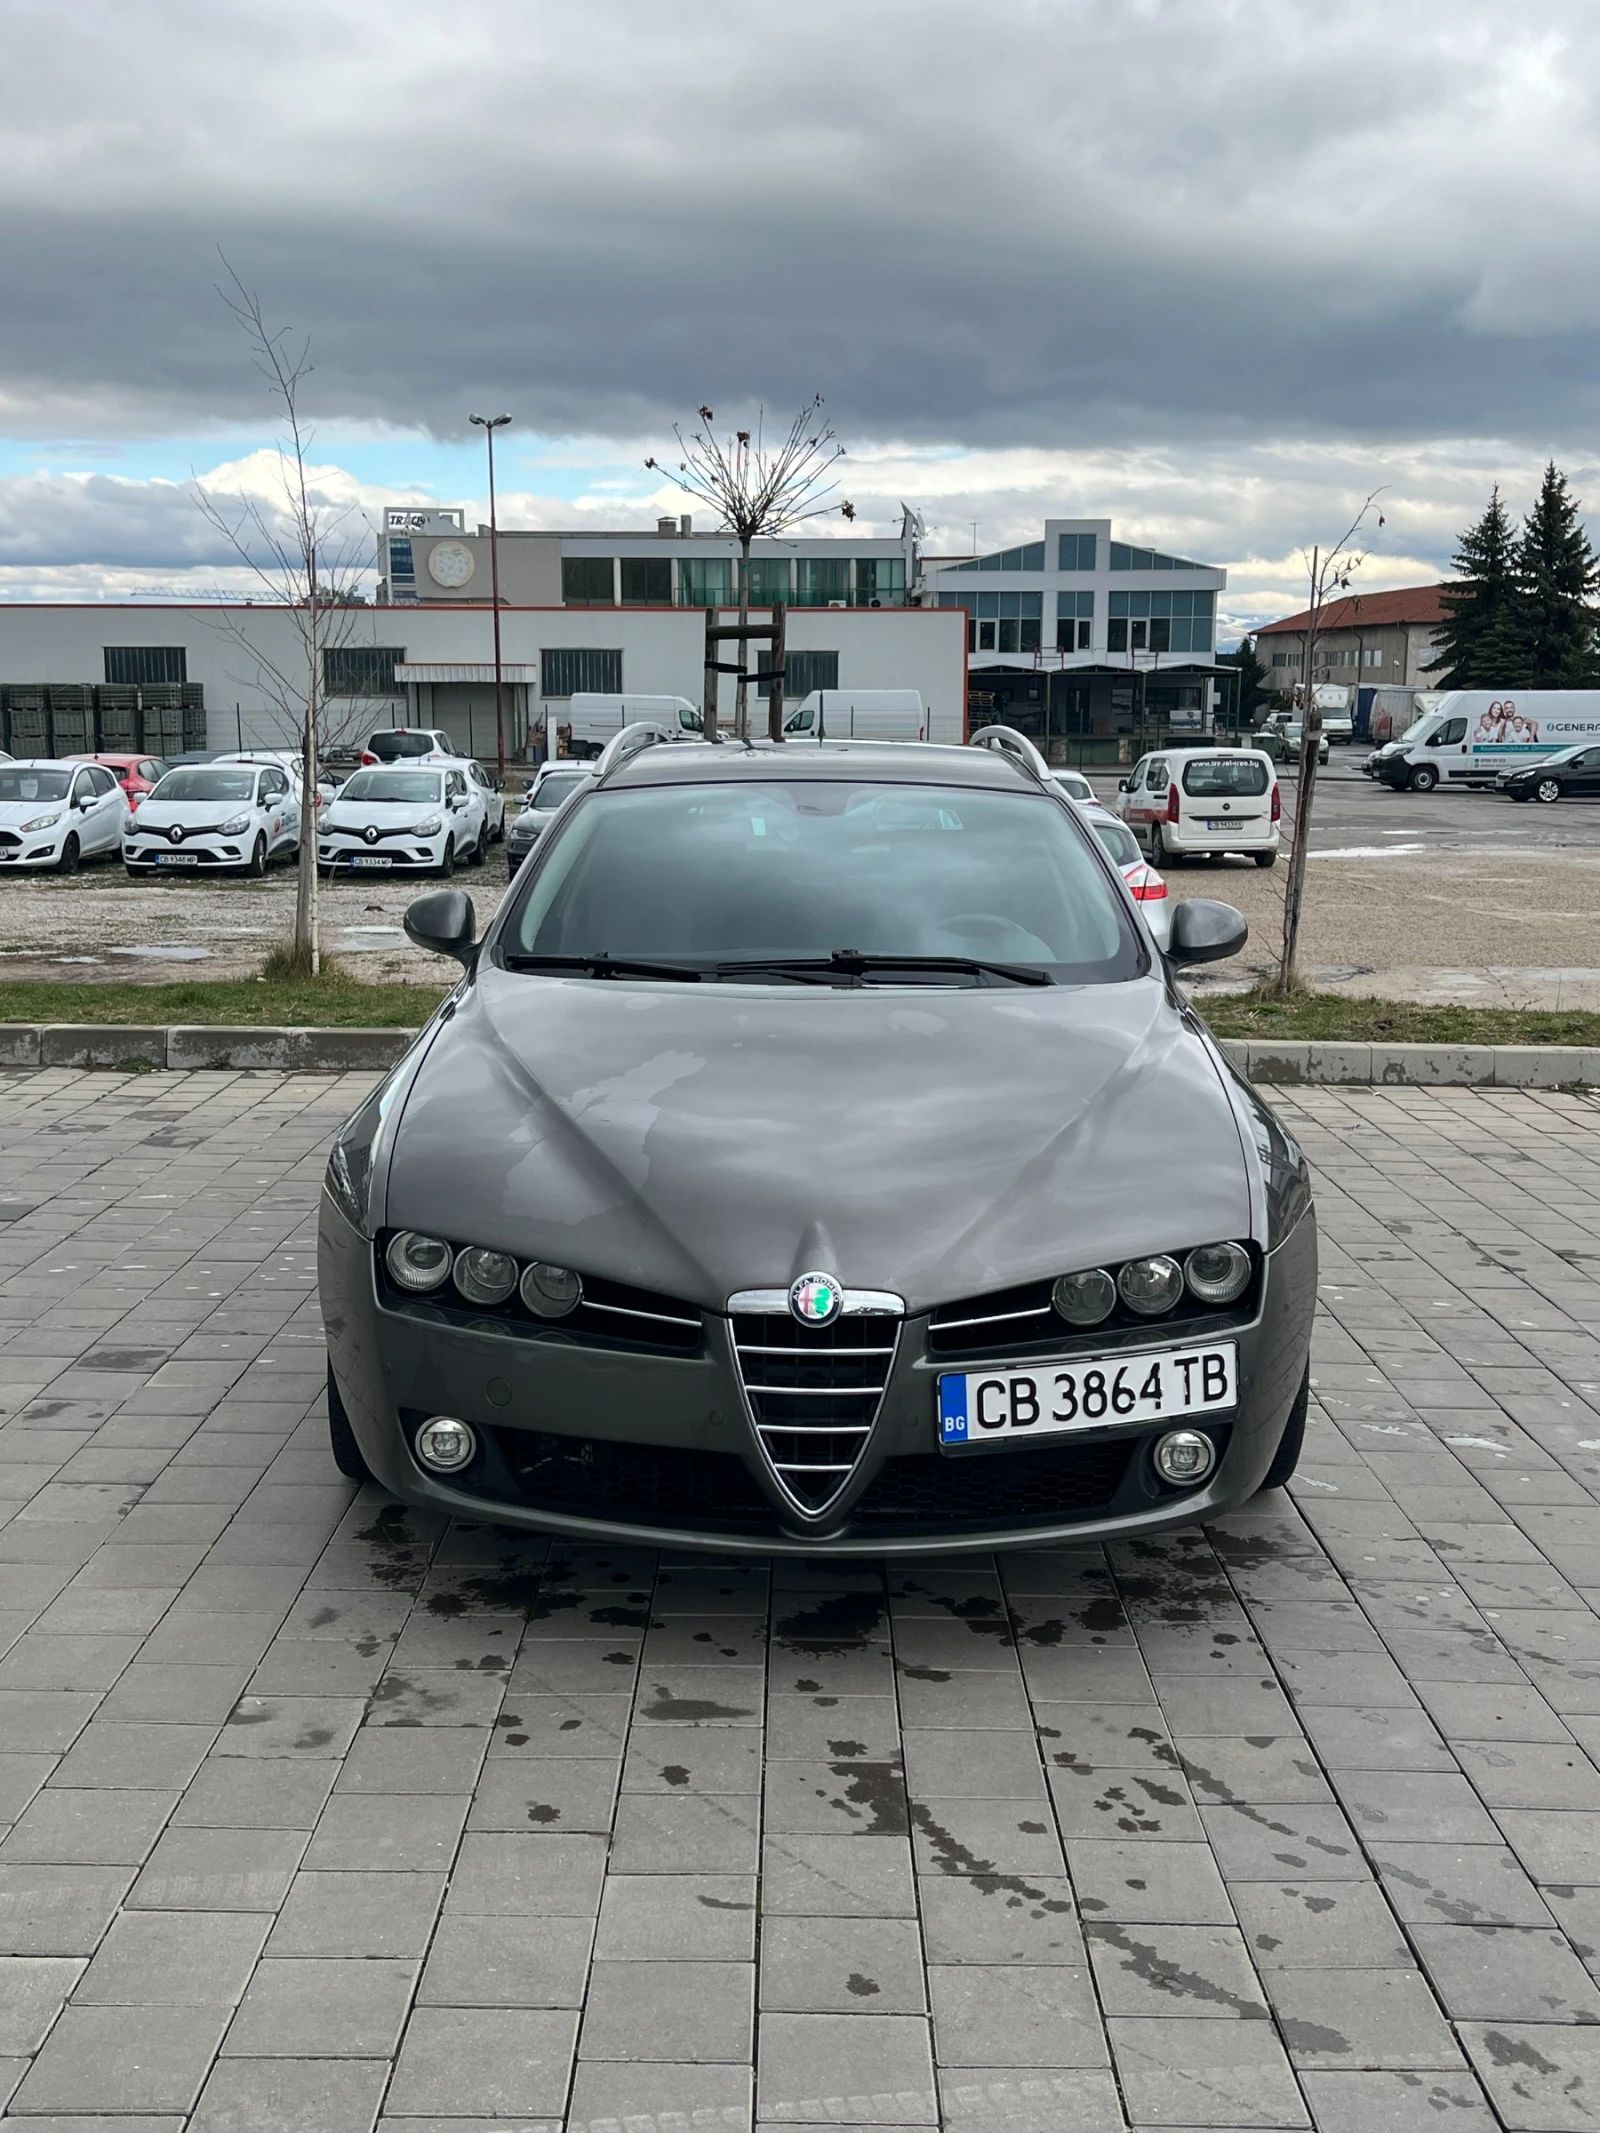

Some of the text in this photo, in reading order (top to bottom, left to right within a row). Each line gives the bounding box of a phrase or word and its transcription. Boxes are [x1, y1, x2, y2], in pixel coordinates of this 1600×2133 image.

[976, 1353, 1228, 1429] CB 3864 TB
[945, 1416, 965, 1432] BG
